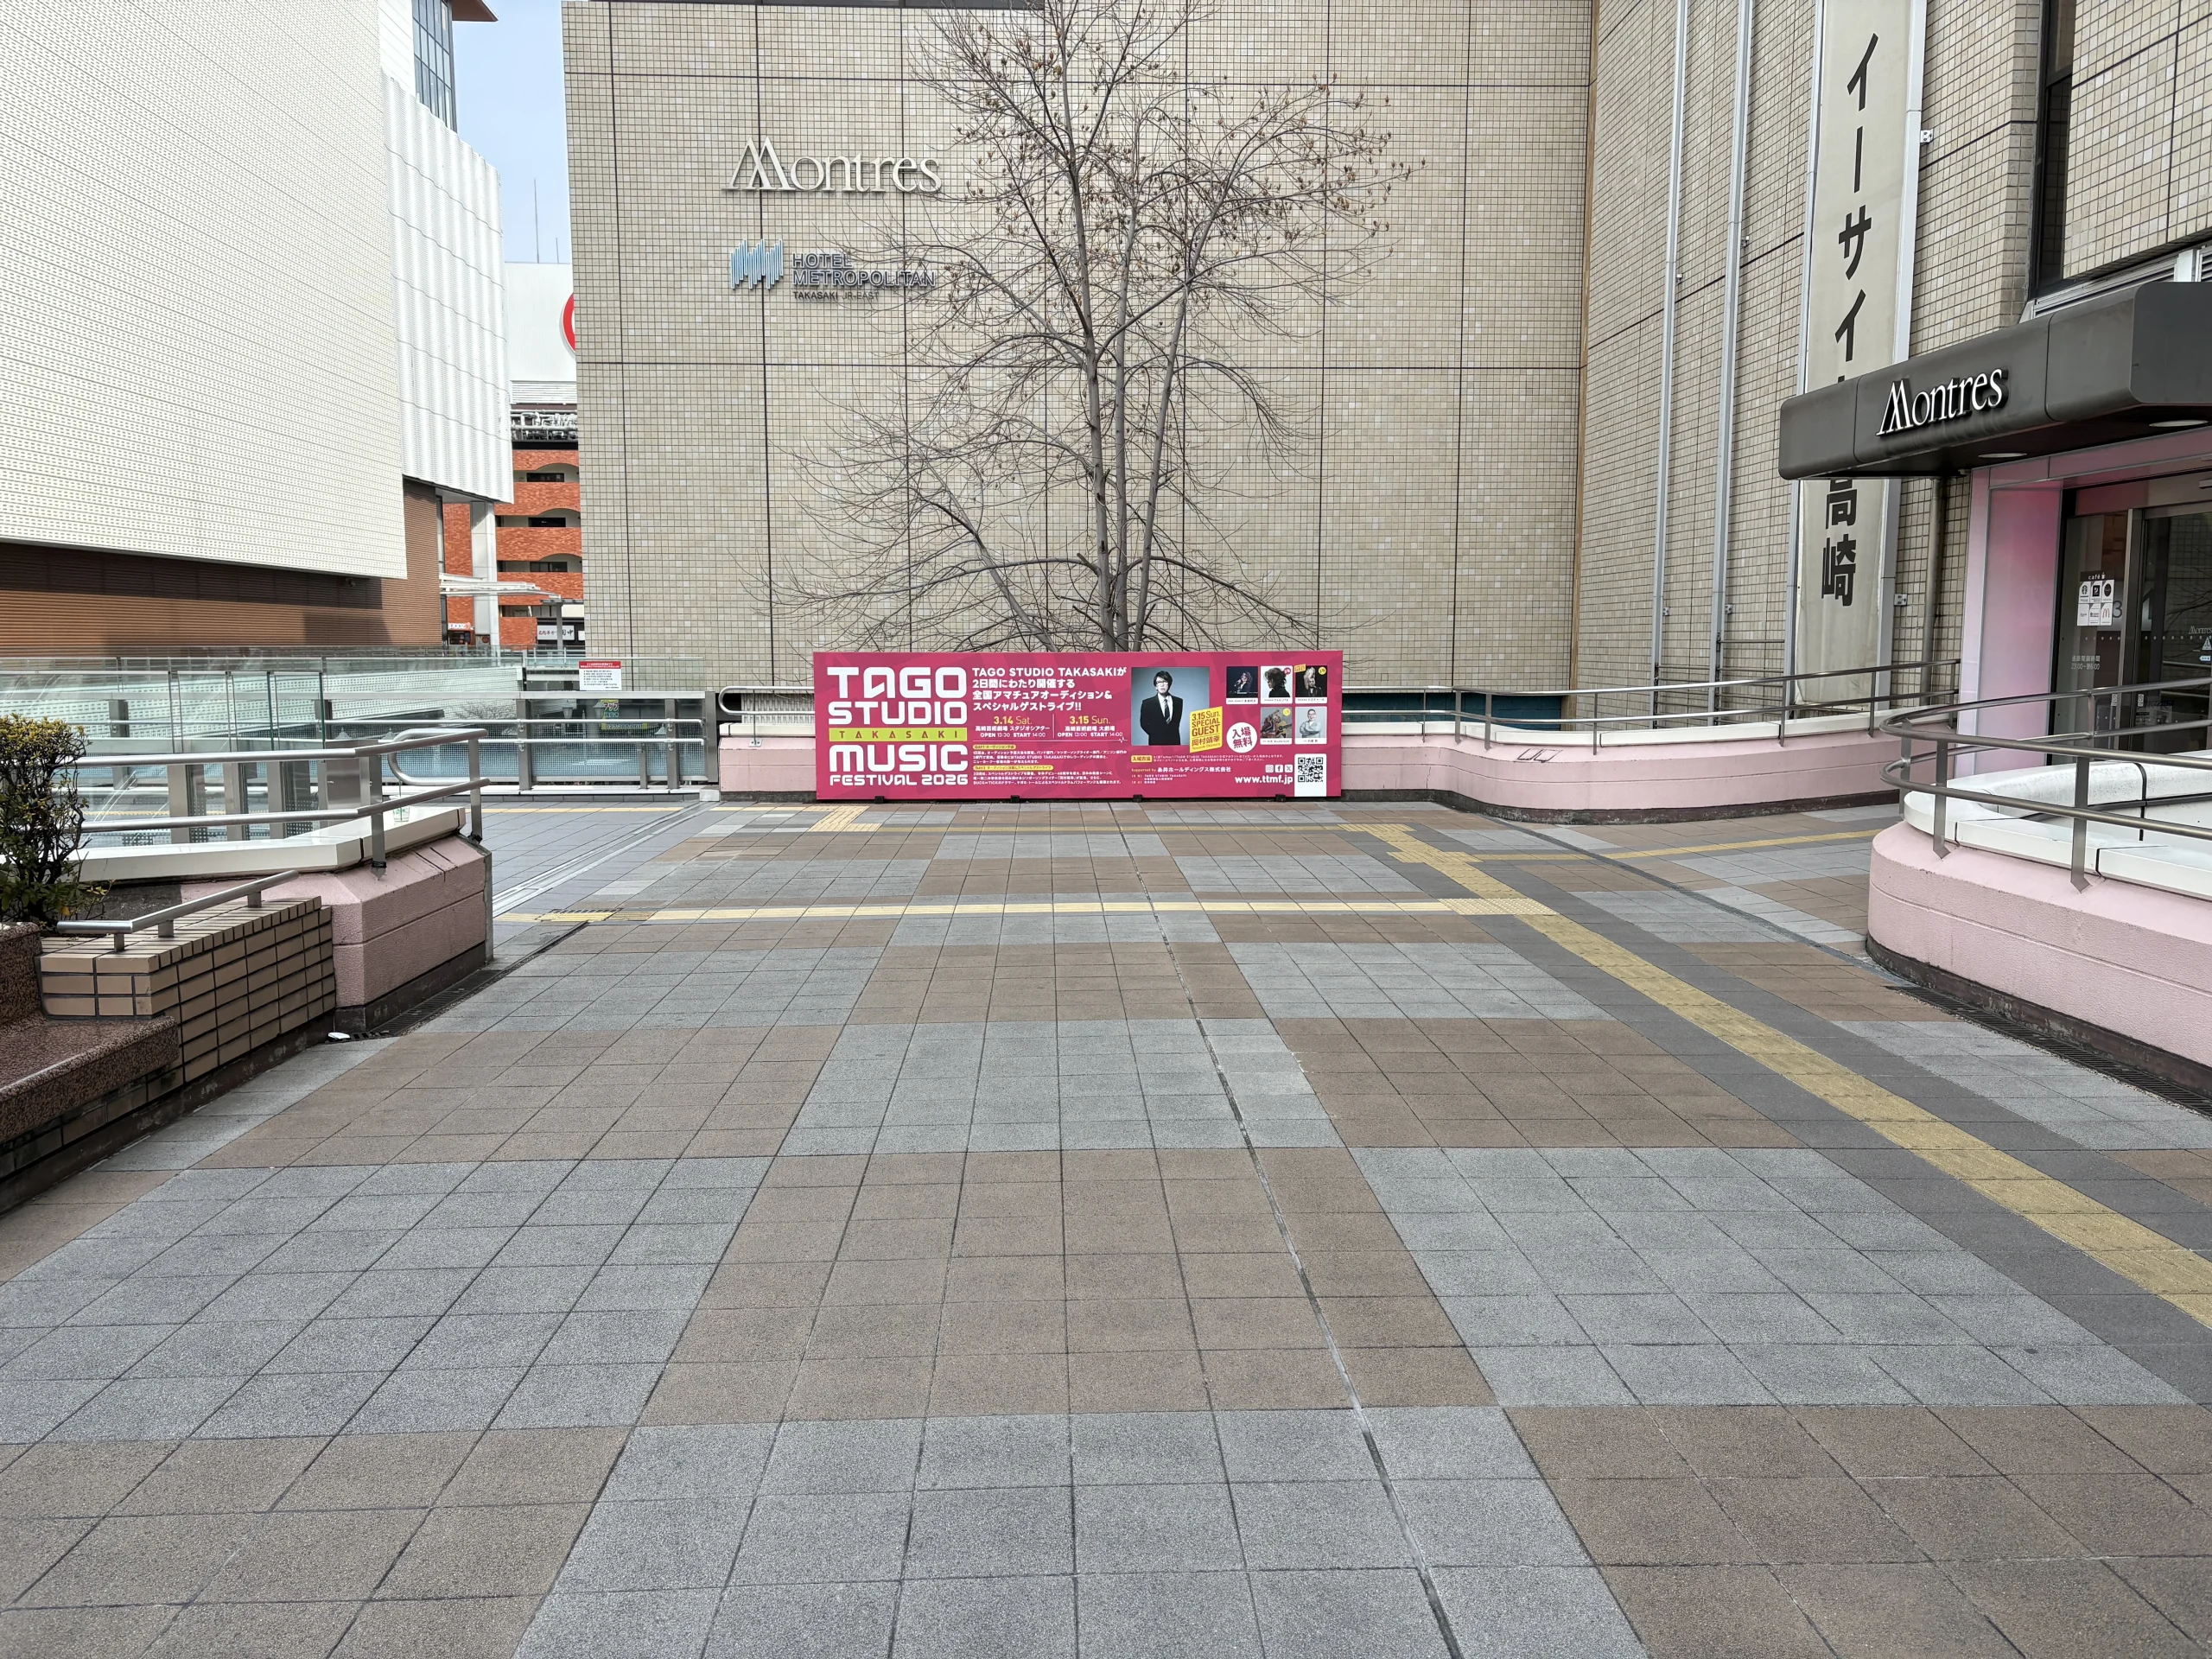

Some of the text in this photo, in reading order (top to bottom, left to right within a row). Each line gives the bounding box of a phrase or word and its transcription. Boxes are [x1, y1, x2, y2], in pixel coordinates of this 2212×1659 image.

[721, 137, 943, 193] Montres
[792, 252, 853, 269] HOTEL
[792, 270, 936, 287] METROPOLITAN
[792, 291, 838, 300] TAKASAKI
[1875, 368, 2003, 436] Montres
[972, 667, 1127, 677] TAGO STUDIO TAKASAKIが
[827, 667, 967, 699] TAGO
[972, 678, 1075, 689] 2日間にわたり開催する
[828, 701, 968, 725] STUDIO
[1192, 710, 1221, 721] 3.15 Sun.
[994, 715, 1033, 724] 3.14 Sat.
[1070, 715, 1111, 724] 3.15 Sun.
[1192, 717, 1220, 728] SPECIAL
[839, 730, 958, 739] TAKASAKI
[1192, 724, 1220, 736] GUEST
[1232, 726, 1251, 739] 入場
[1232, 736, 1252, 749] 無料
[829, 744, 969, 772] MUSIC
[830, 773, 969, 785] FESTIVAL 2026
[1235, 774, 1294, 785] www.ttmf.jp
